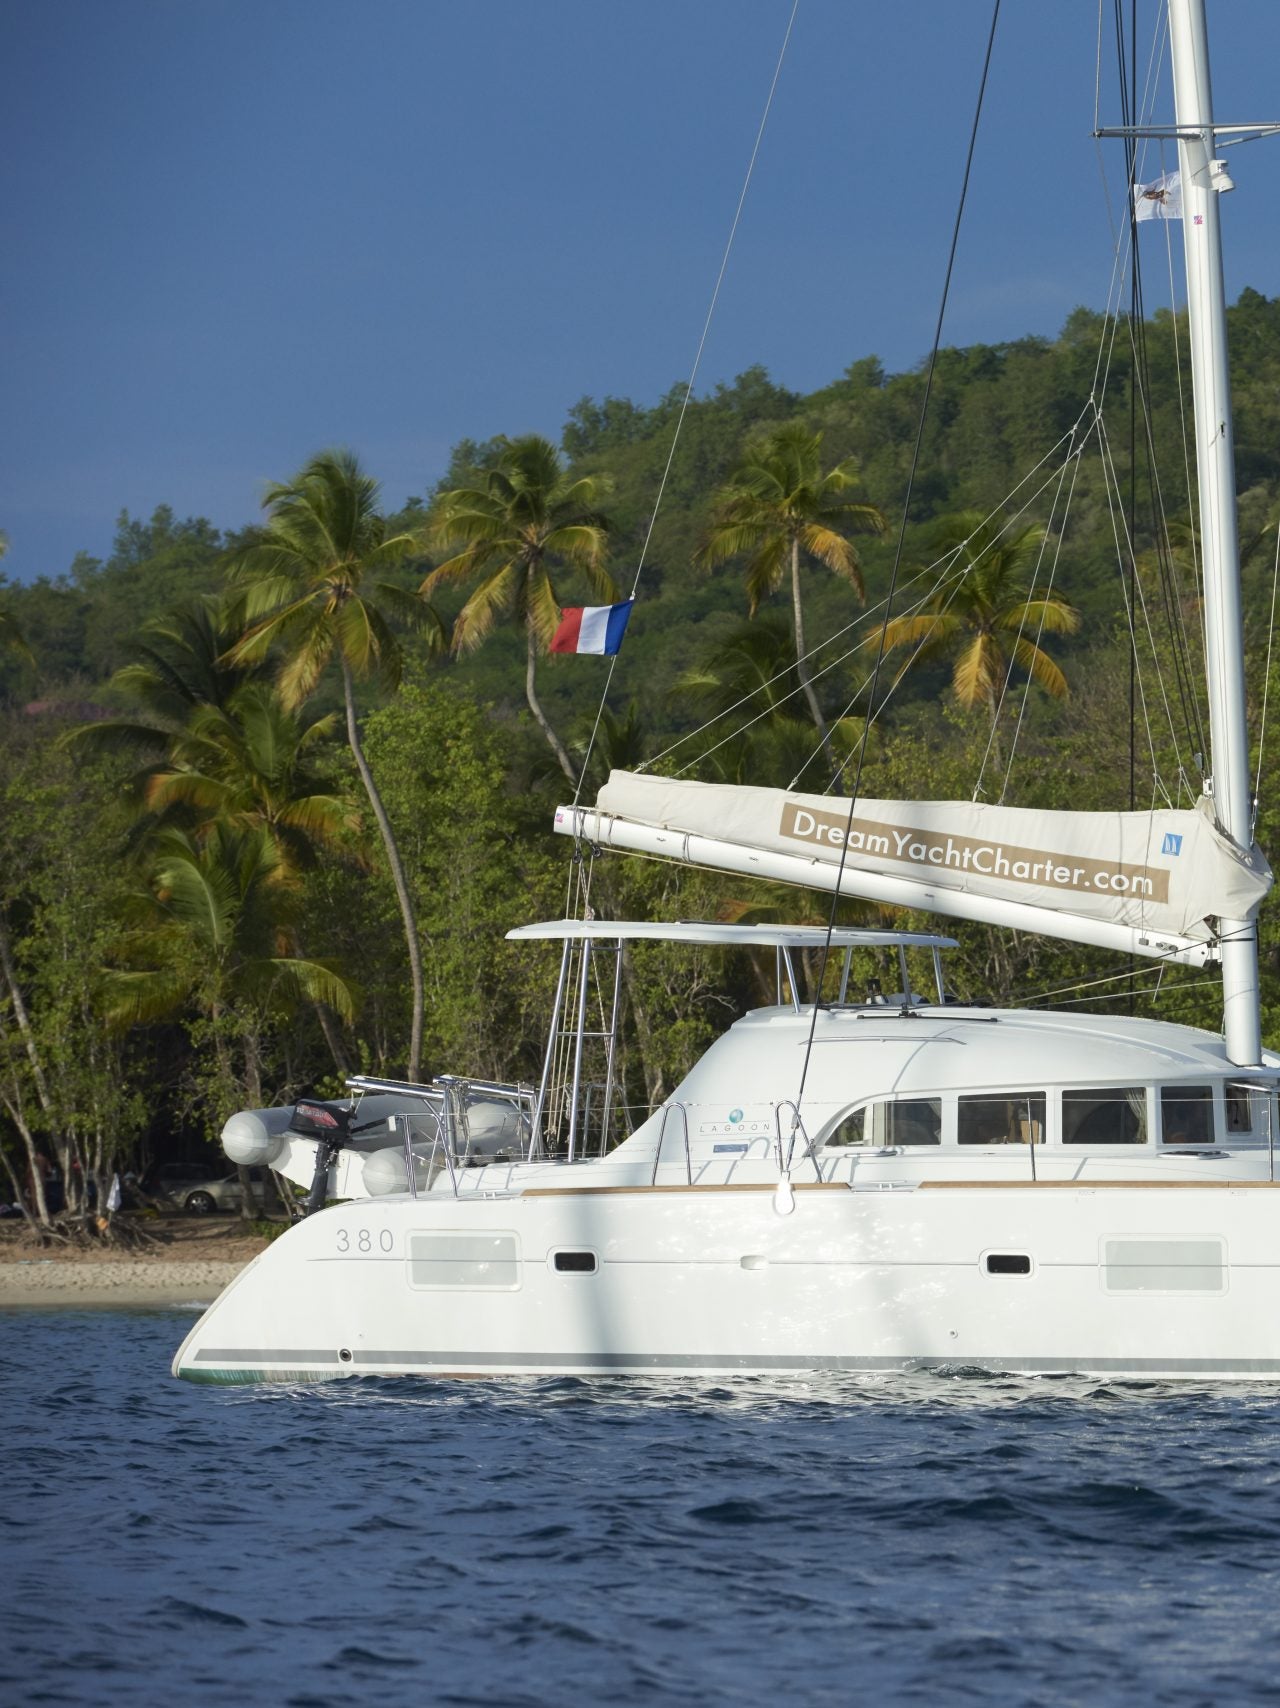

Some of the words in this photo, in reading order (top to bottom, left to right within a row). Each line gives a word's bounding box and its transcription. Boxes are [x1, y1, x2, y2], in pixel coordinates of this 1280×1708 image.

[792, 810, 1154, 896] DreamYachtCharter.com
[699, 1123, 770, 1133] LAGOON
[336, 1229, 394, 1253] 380
